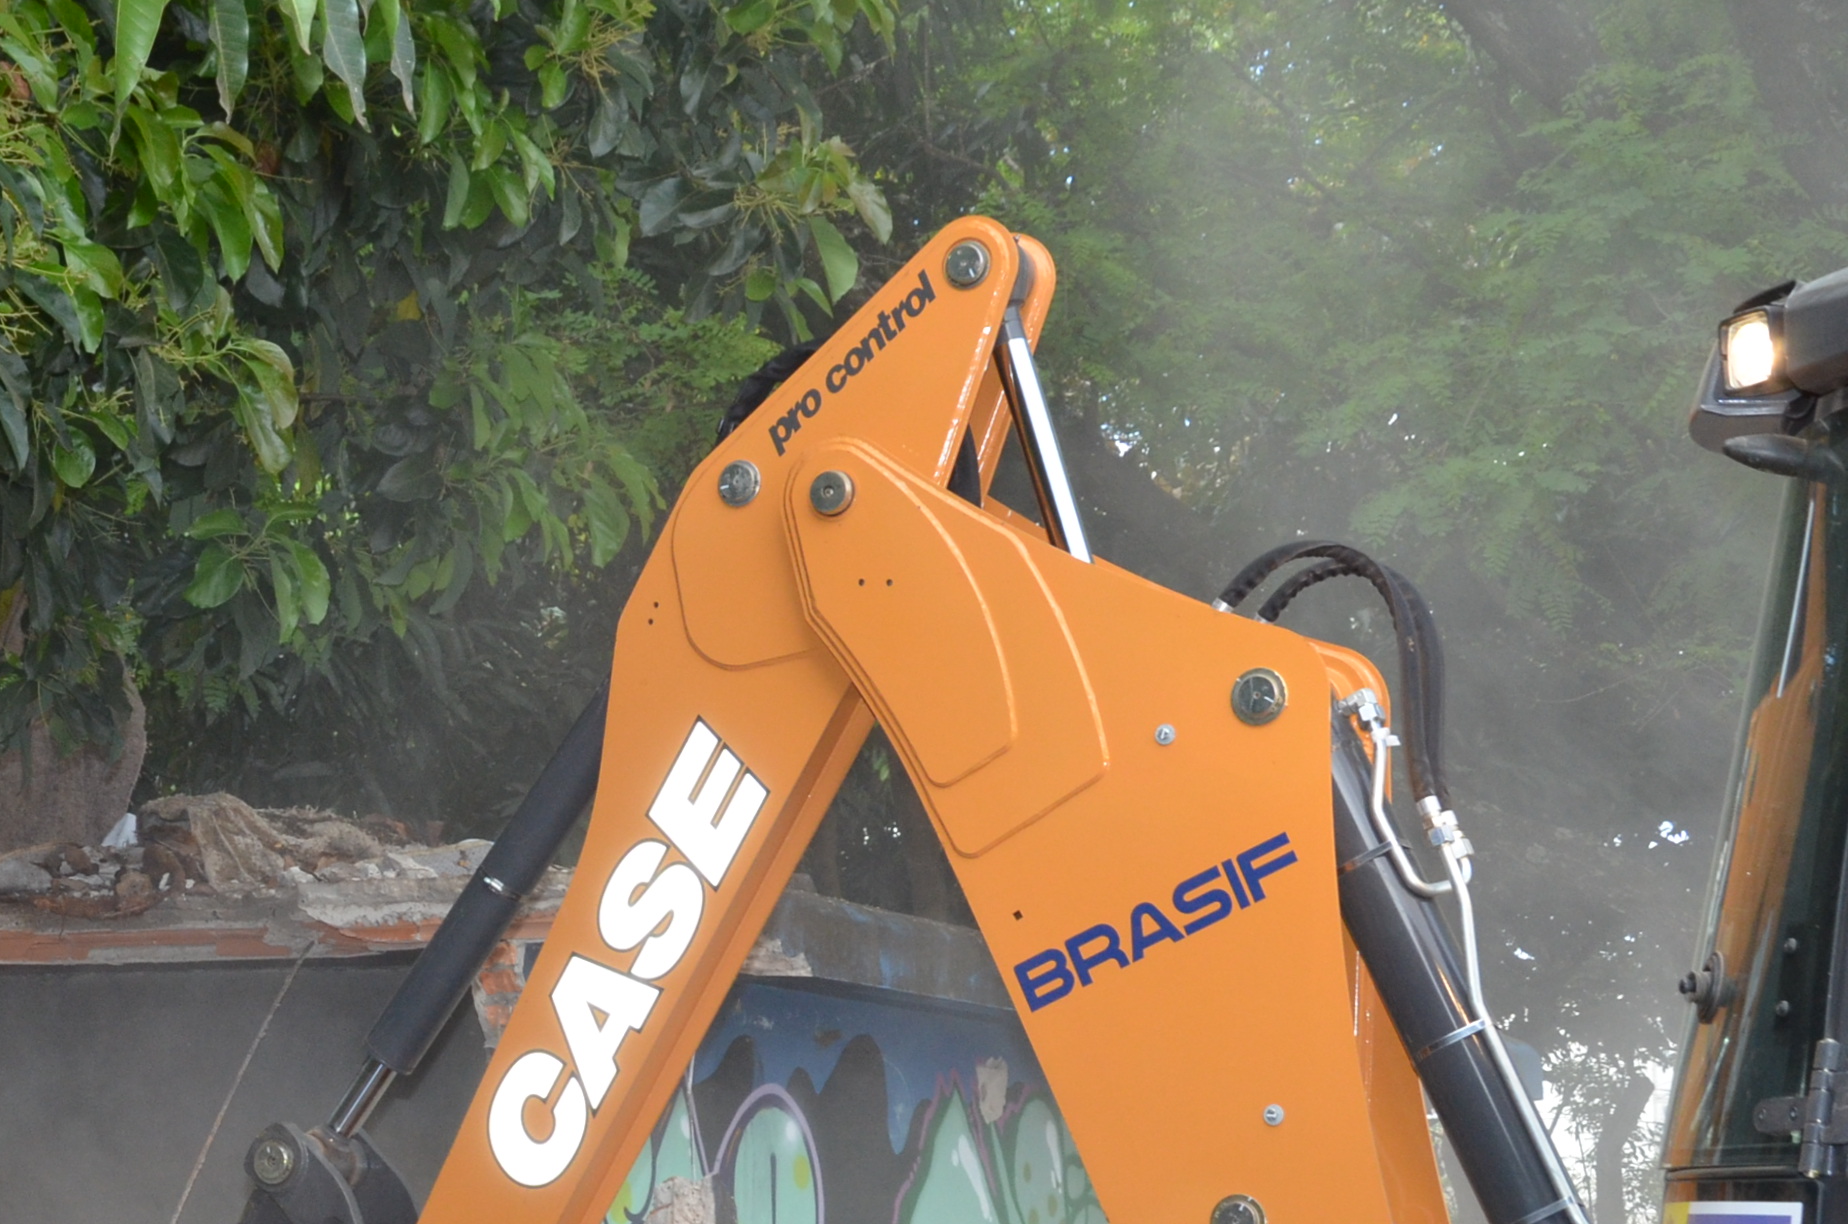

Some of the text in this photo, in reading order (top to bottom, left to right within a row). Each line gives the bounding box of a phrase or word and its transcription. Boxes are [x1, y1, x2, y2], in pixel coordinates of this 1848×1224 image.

[767, 269, 936, 456] pro control
[487, 715, 771, 1189] CASE
[1014, 832, 1299, 1013] BRASIF
